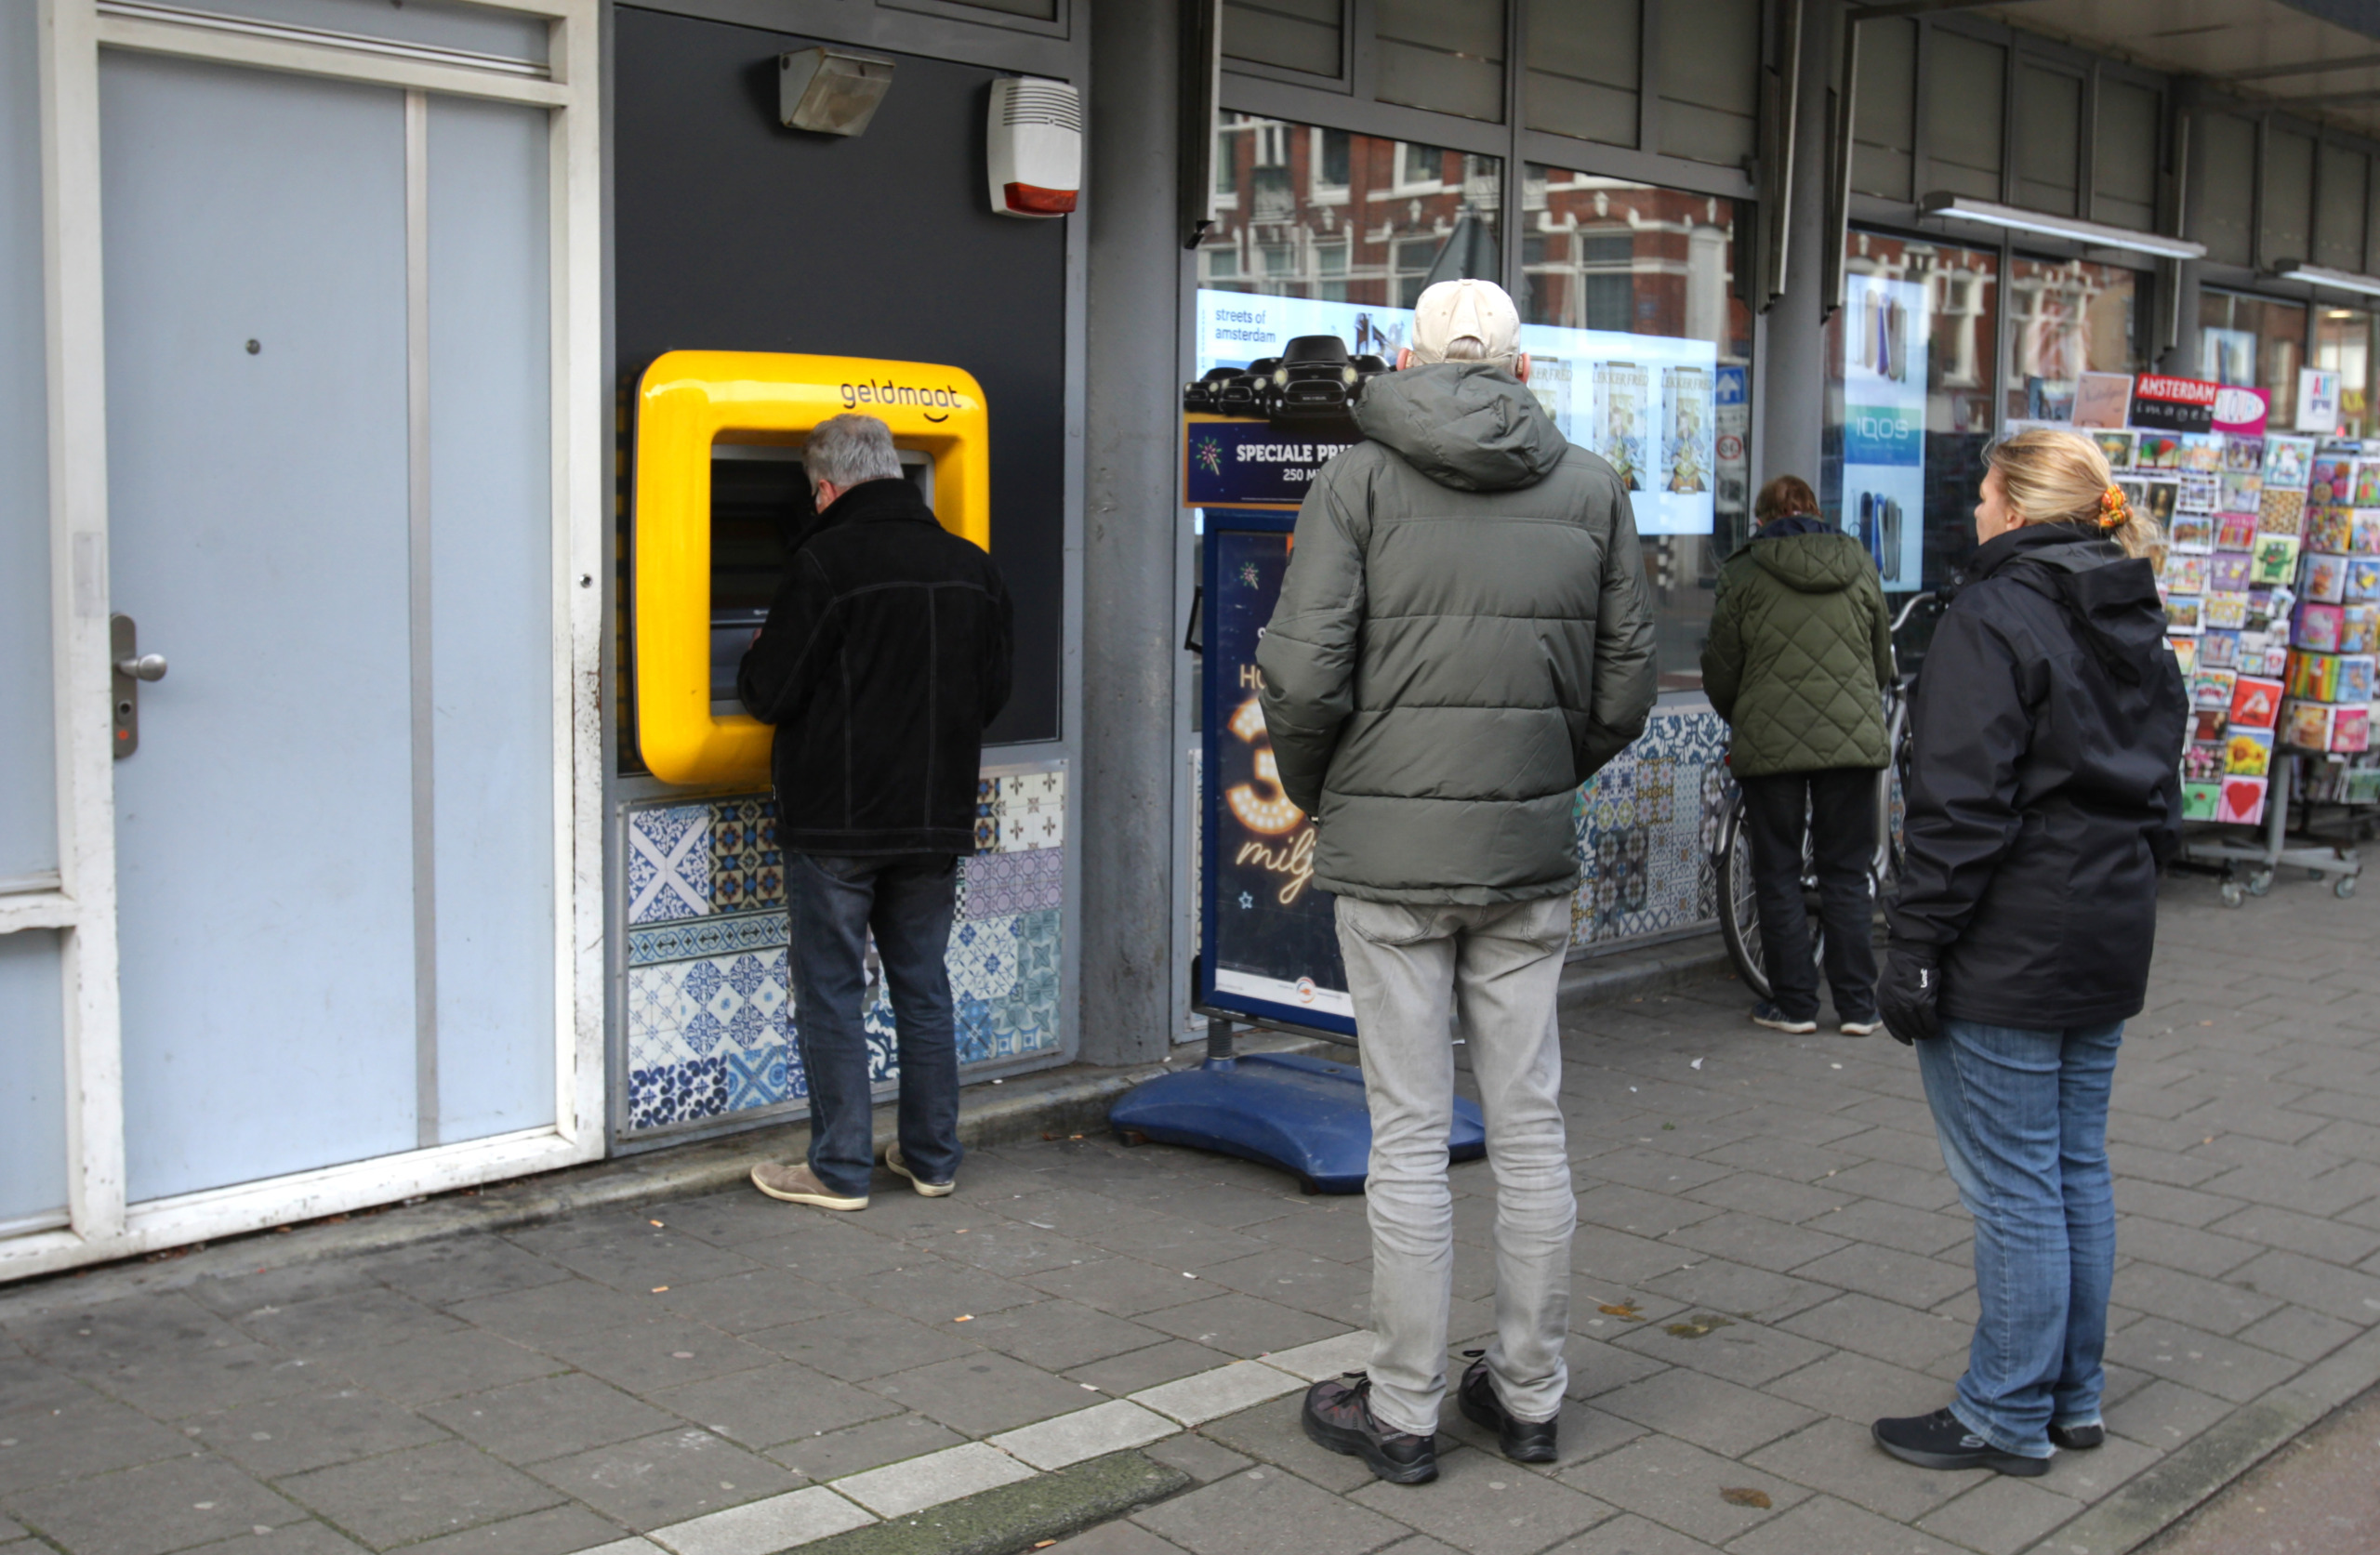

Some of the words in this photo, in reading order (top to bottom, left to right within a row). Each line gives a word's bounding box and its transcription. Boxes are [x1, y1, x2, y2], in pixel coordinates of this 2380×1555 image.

[1215, 309, 1253, 323] streets
[1255, 310, 1266, 324] of
[1215, 327, 1276, 343] amsterdam
[840, 379, 961, 409] geldmaat
[2139, 376, 2216, 402] AMSTERDAM
[1857, 416, 1909, 441] IQOS
[1236, 443, 1313, 462] SPECIALE
[1283, 468, 1303, 481] 250
[1236, 827, 1316, 904] milj
